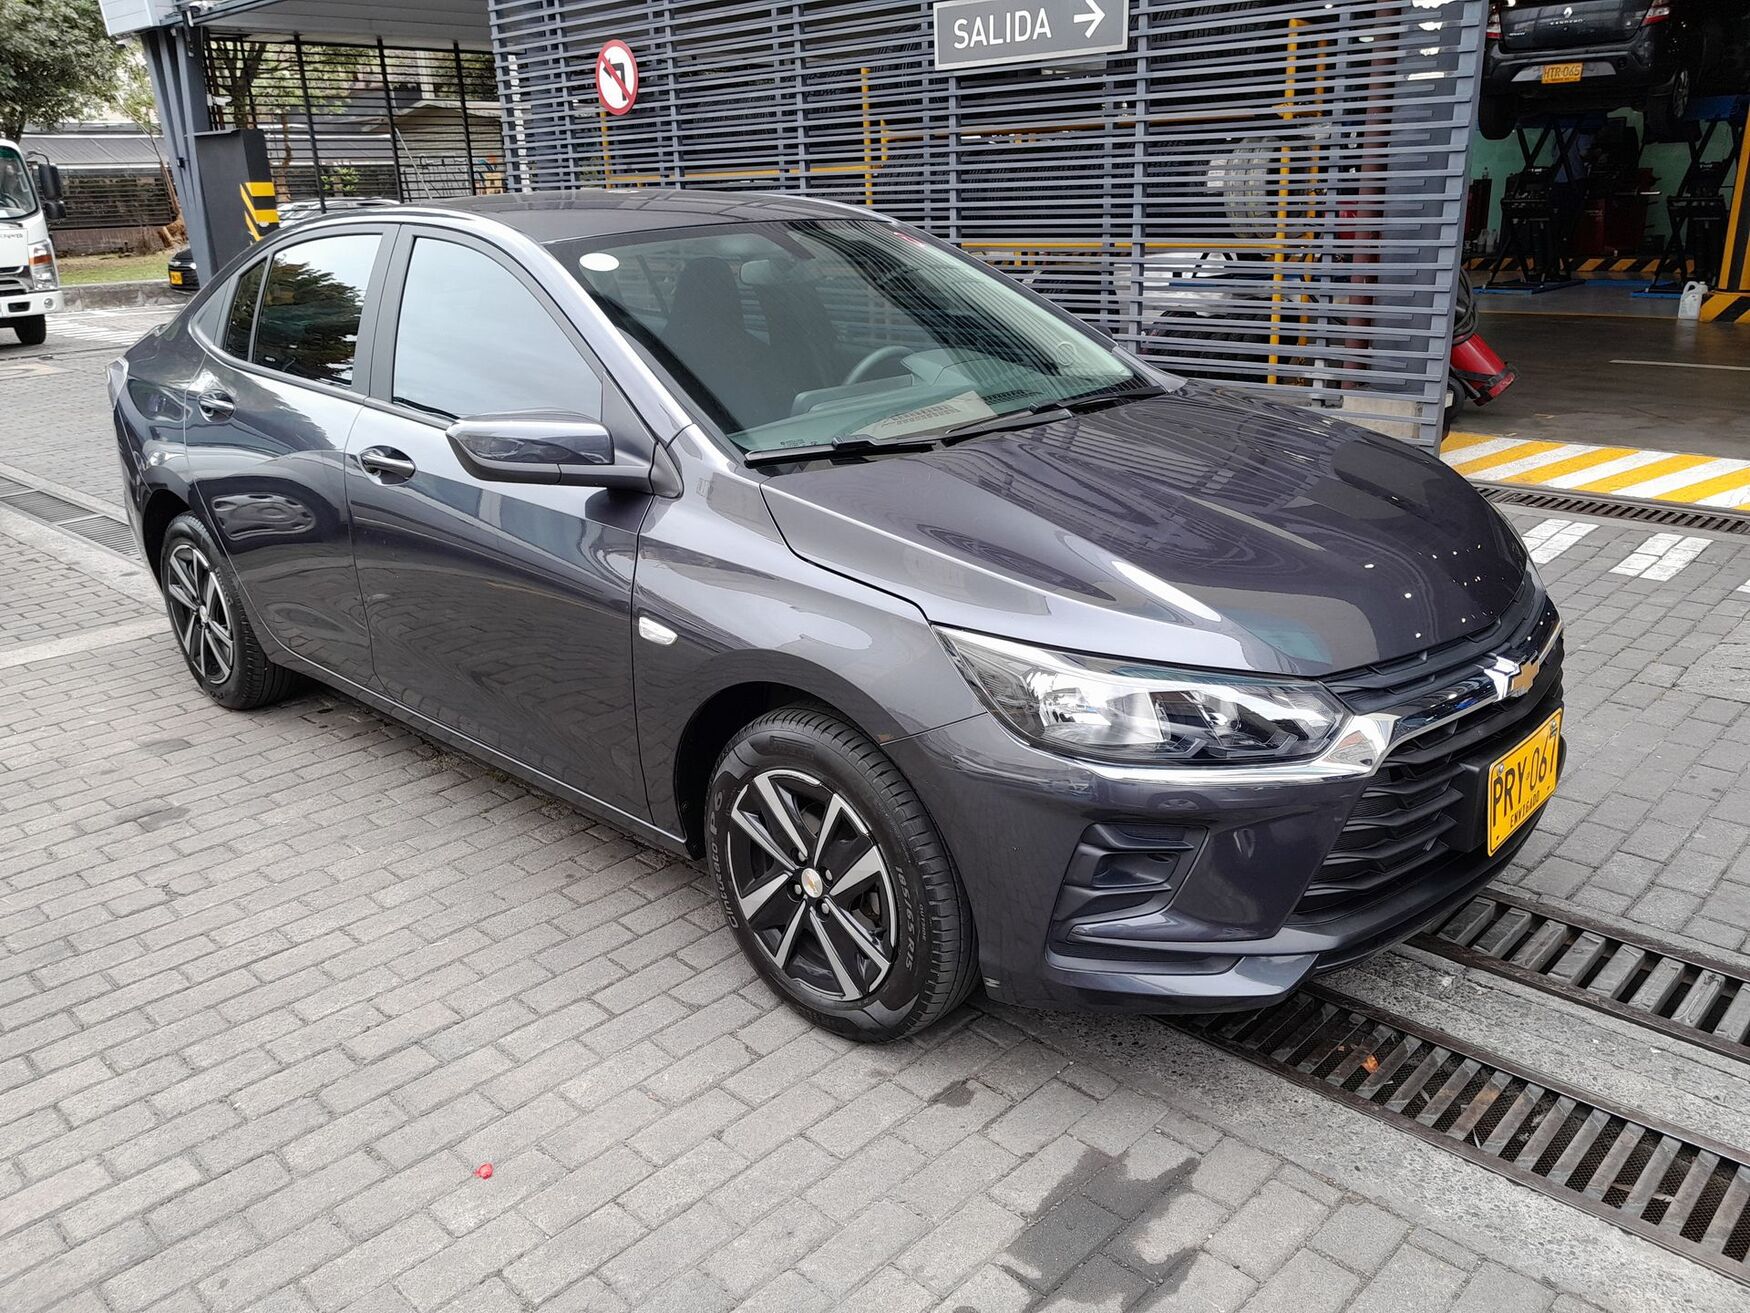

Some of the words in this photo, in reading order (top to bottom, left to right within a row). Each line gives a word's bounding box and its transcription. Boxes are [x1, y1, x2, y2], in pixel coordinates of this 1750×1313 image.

[953, 7, 1052, 49] SALIDA
[1509, 790, 1540, 828] ENVIGADO
[895, 865, 915, 935] 185/65
[905, 936, 915, 971] R15
